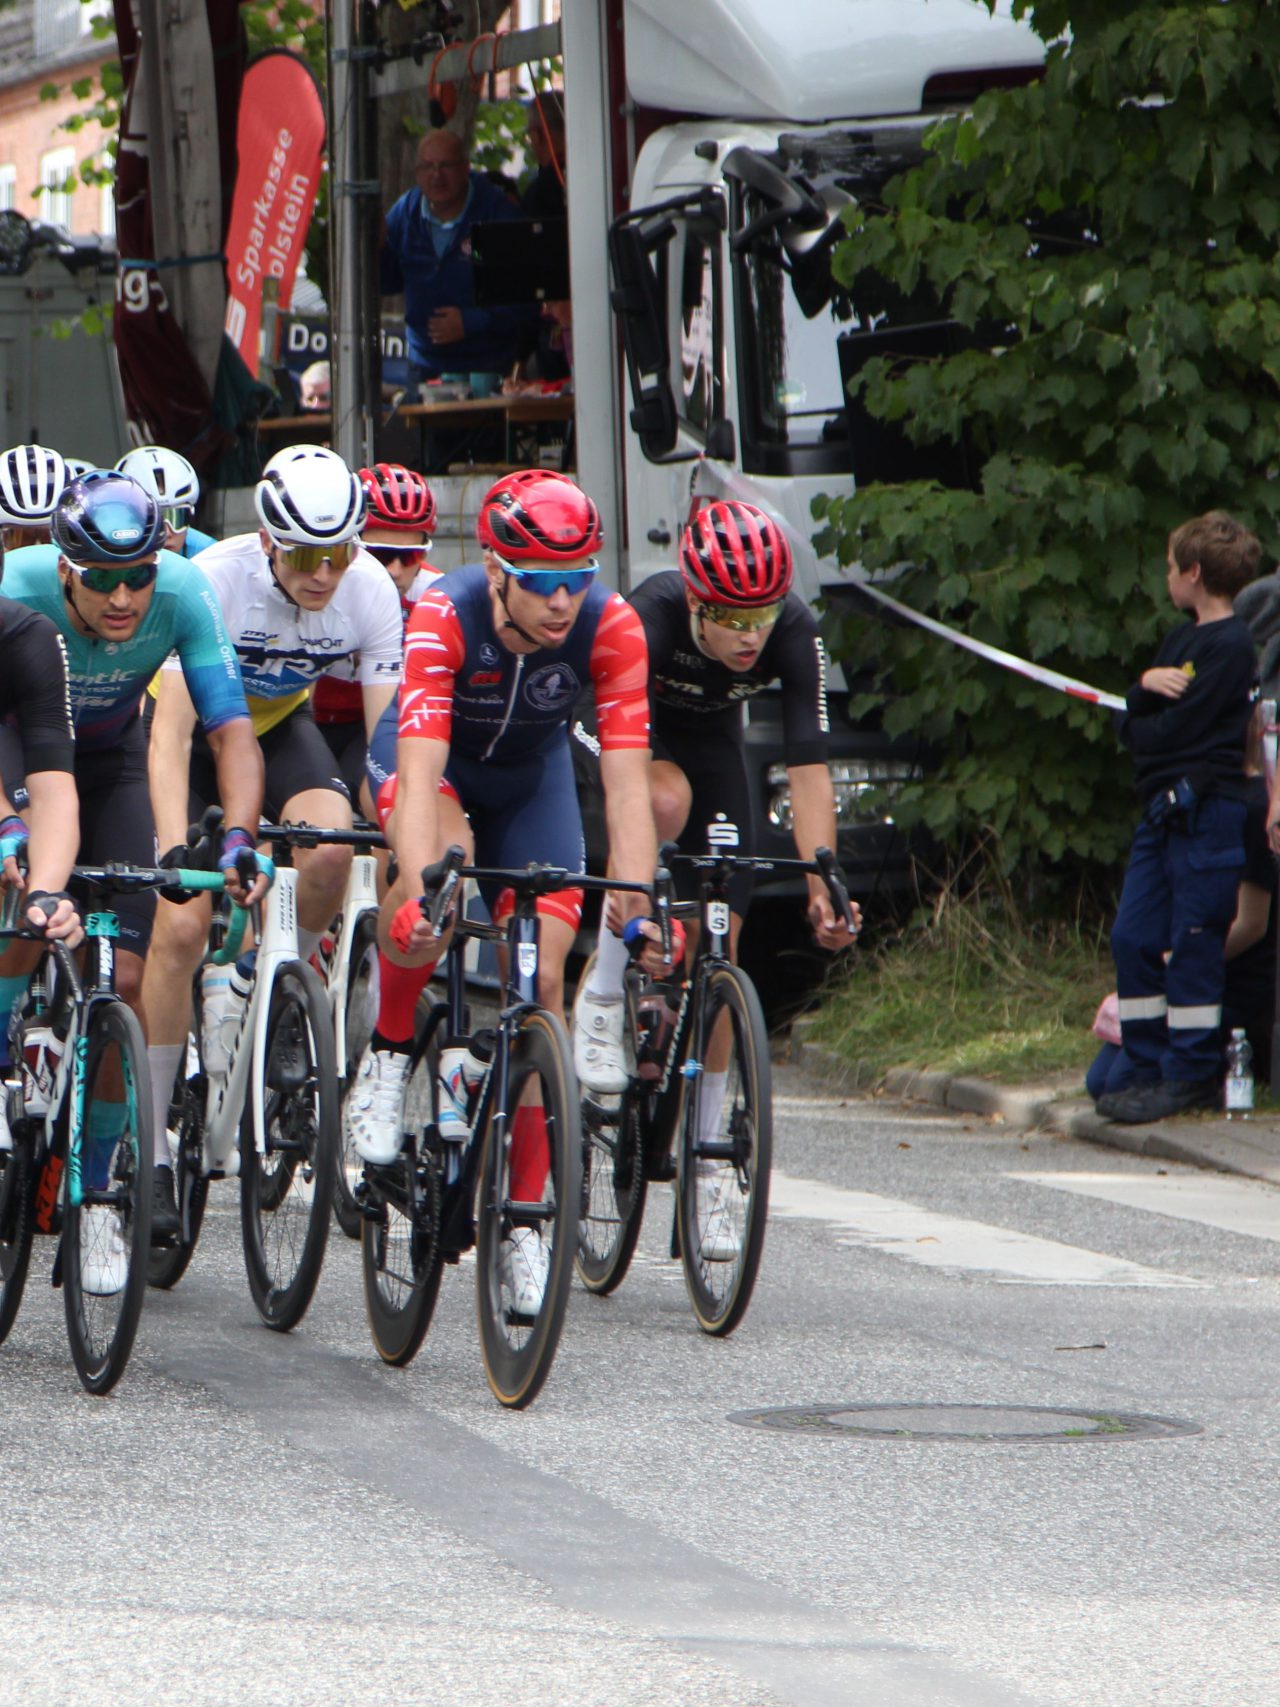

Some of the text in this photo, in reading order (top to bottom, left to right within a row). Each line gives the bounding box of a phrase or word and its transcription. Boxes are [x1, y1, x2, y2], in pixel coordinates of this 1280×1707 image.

[237, 128, 294, 290] Sparkasse
[270, 173, 310, 279] olstein
[201, 590, 238, 680] Autohaus Ortner
[814, 637, 830, 733] SHIMANO
